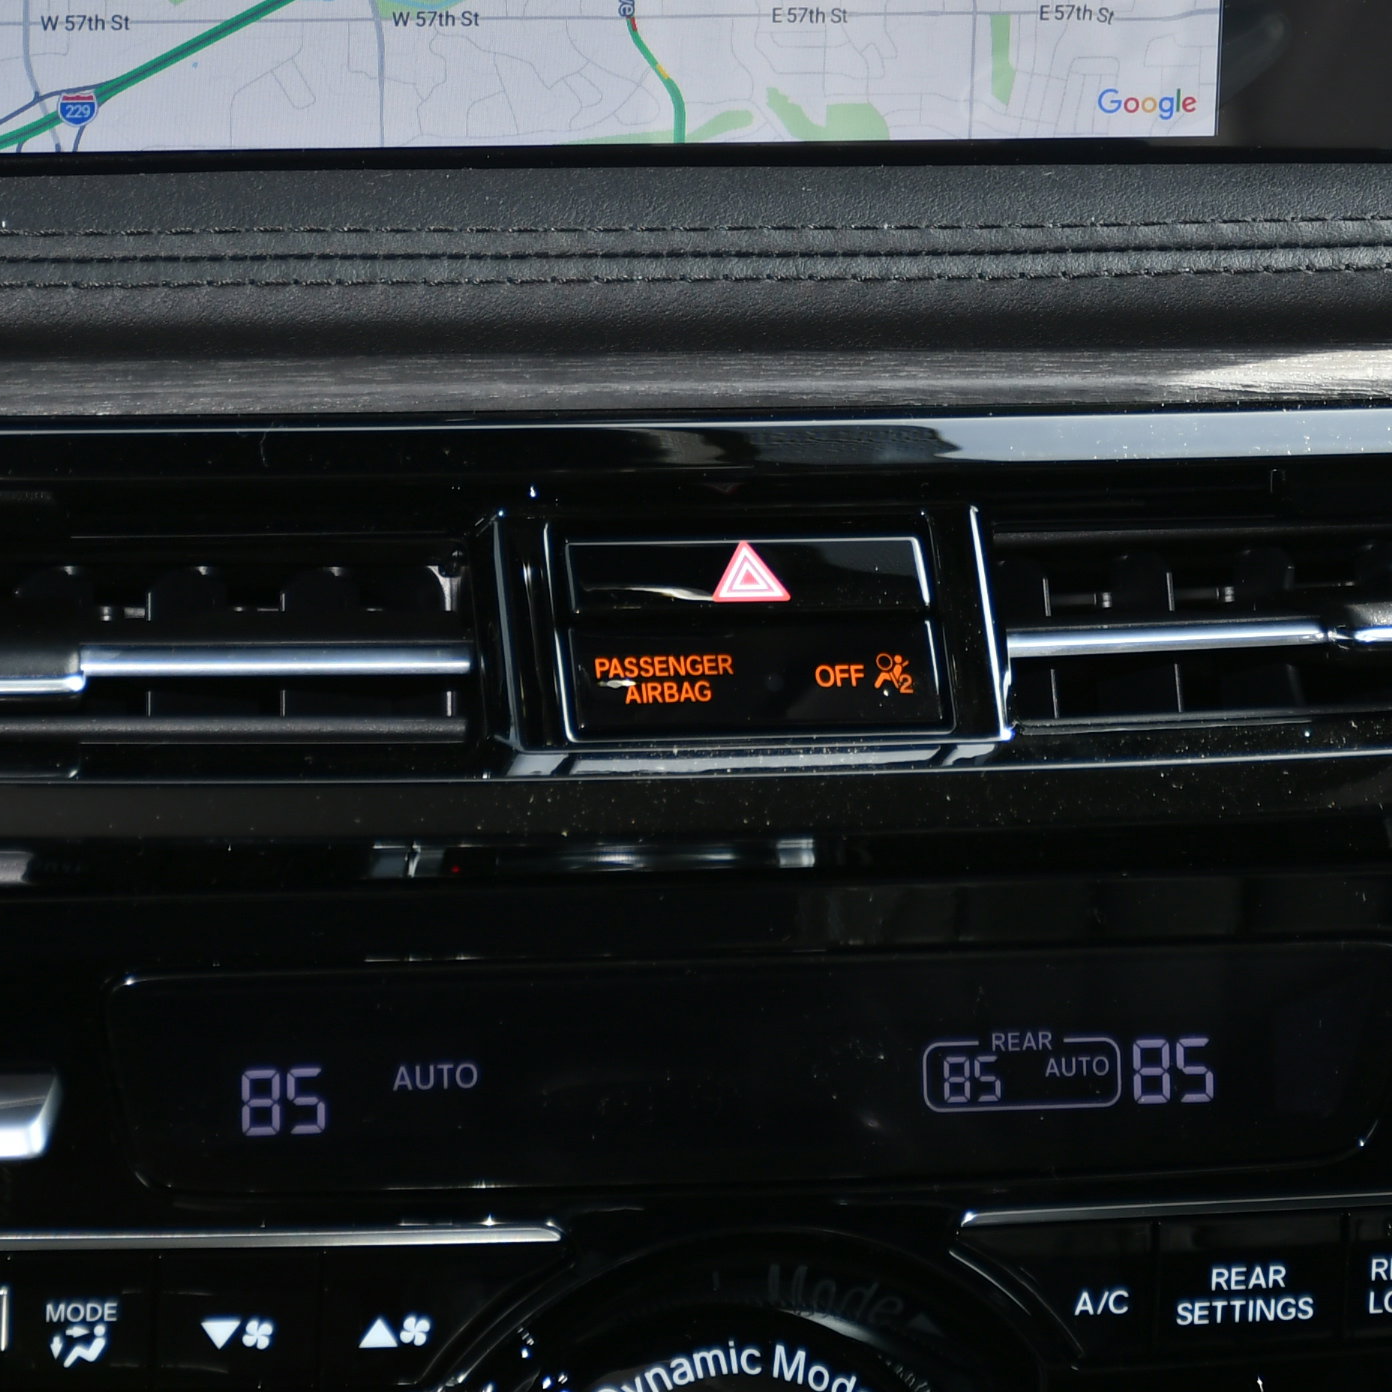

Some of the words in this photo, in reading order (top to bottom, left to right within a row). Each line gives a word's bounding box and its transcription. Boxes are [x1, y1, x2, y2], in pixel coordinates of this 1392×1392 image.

[41, 15, 59, 31] W
[65, 14, 105, 31] 57th
[111, 14, 130, 31] St
[392, 11, 410, 27] W
[416, 10, 455, 27] 57th
[461, 10, 479, 26] St
[772, 7, 783, 23] E
[787, 7, 825, 24] 57th
[830, 8, 848, 24] St
[1039, 4, 1050, 21] E
[1054, 4, 1093, 21] 57th
[1096, 7, 1114, 25] St
[65, 104, 91, 118] 229
[1097, 88, 1197, 120] Google
[595, 653, 734, 679] PASSENGER
[815, 664, 865, 688] OFF
[625, 681, 712, 705] AIRBAG
[992, 1031, 1052, 1052] REAR
[943, 1056, 1001, 1104] 85
[1045, 1056, 1109, 1078] AUTO
[1132, 1038, 1214, 1104] 85
[241, 1069, 326, 1137] 85
[393, 1063, 478, 1092] AUTO
[1210, 1264, 1287, 1292] REAR
[45, 1303, 118, 1324] MODE
[1074, 1290, 1130, 1317] A/C
[1175, 1296, 1314, 1326] SETTINGS
[593, 1340, 762, 1392] namic
[772, 1344, 870, 1392] Mo
